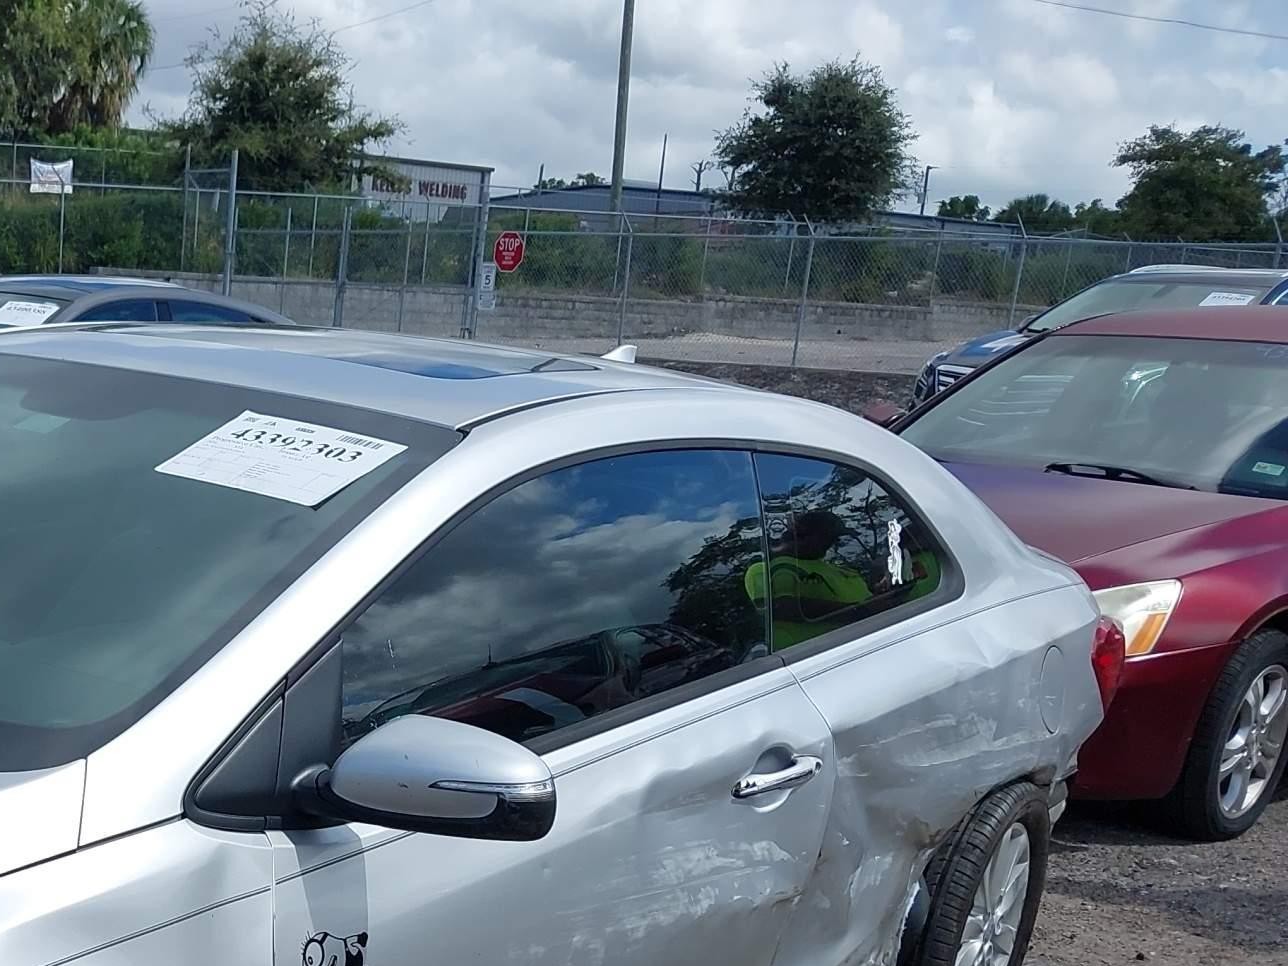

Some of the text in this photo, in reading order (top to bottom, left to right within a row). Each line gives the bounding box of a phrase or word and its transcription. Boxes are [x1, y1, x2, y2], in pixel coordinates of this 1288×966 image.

[418, 181, 468, 200] WELDING
[498, 238, 520, 251] STOP
[484, 274, 492, 286] 5
[230, 428, 363, 463] 43392303
